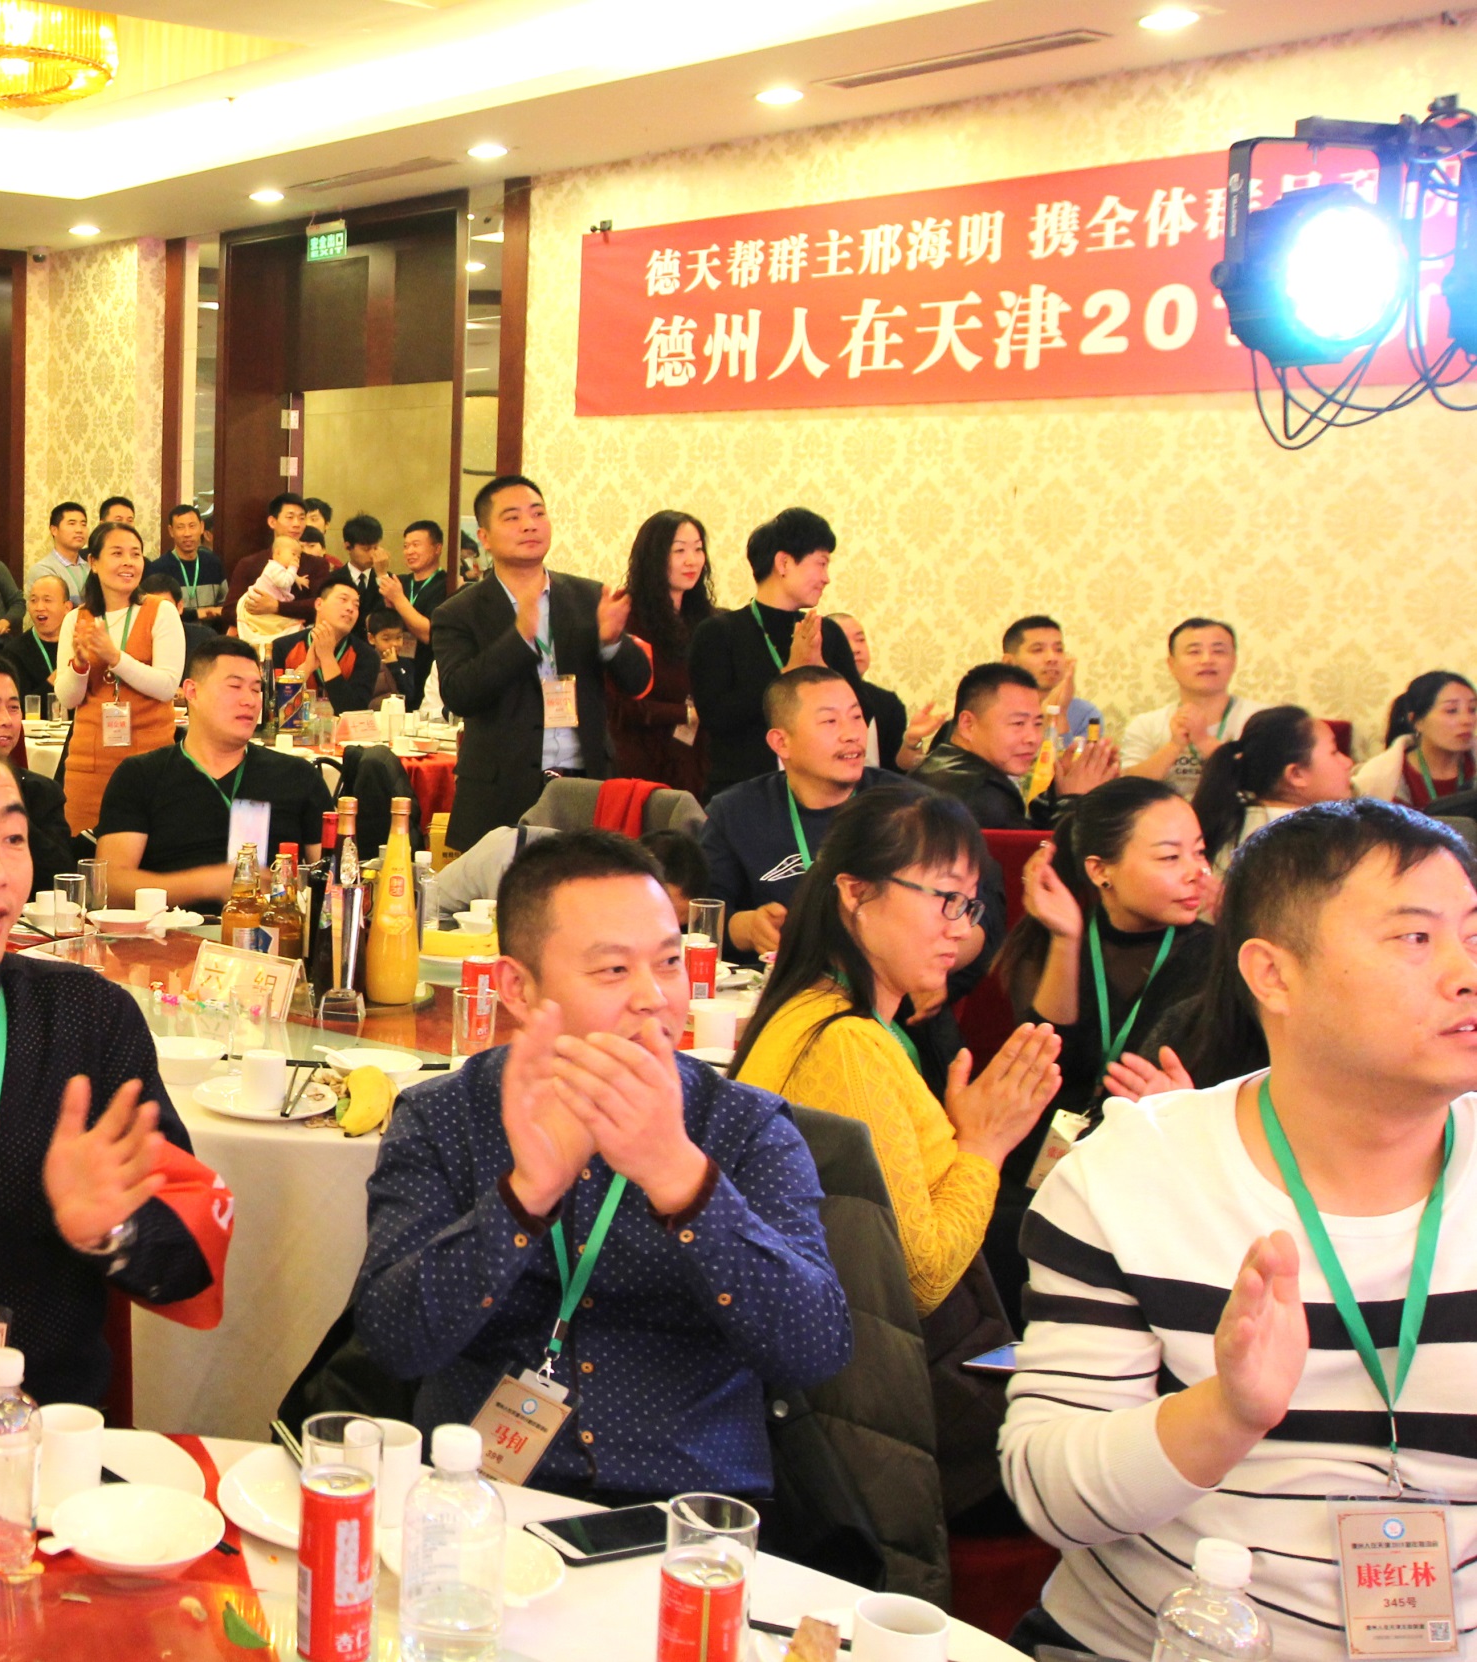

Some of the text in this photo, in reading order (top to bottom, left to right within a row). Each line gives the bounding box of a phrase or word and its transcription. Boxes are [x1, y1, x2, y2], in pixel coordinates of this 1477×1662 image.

[310, 233, 344, 250] 安全出口
[310, 247, 343, 258] EXIT
[644, 209, 1003, 297] 德天帮群主邢海明
[643, 283, 1228, 390] 德州人在天津20
[1356, 1561, 1437, 1589] 康红林
[1383, 1596, 1417, 1608] 345号
